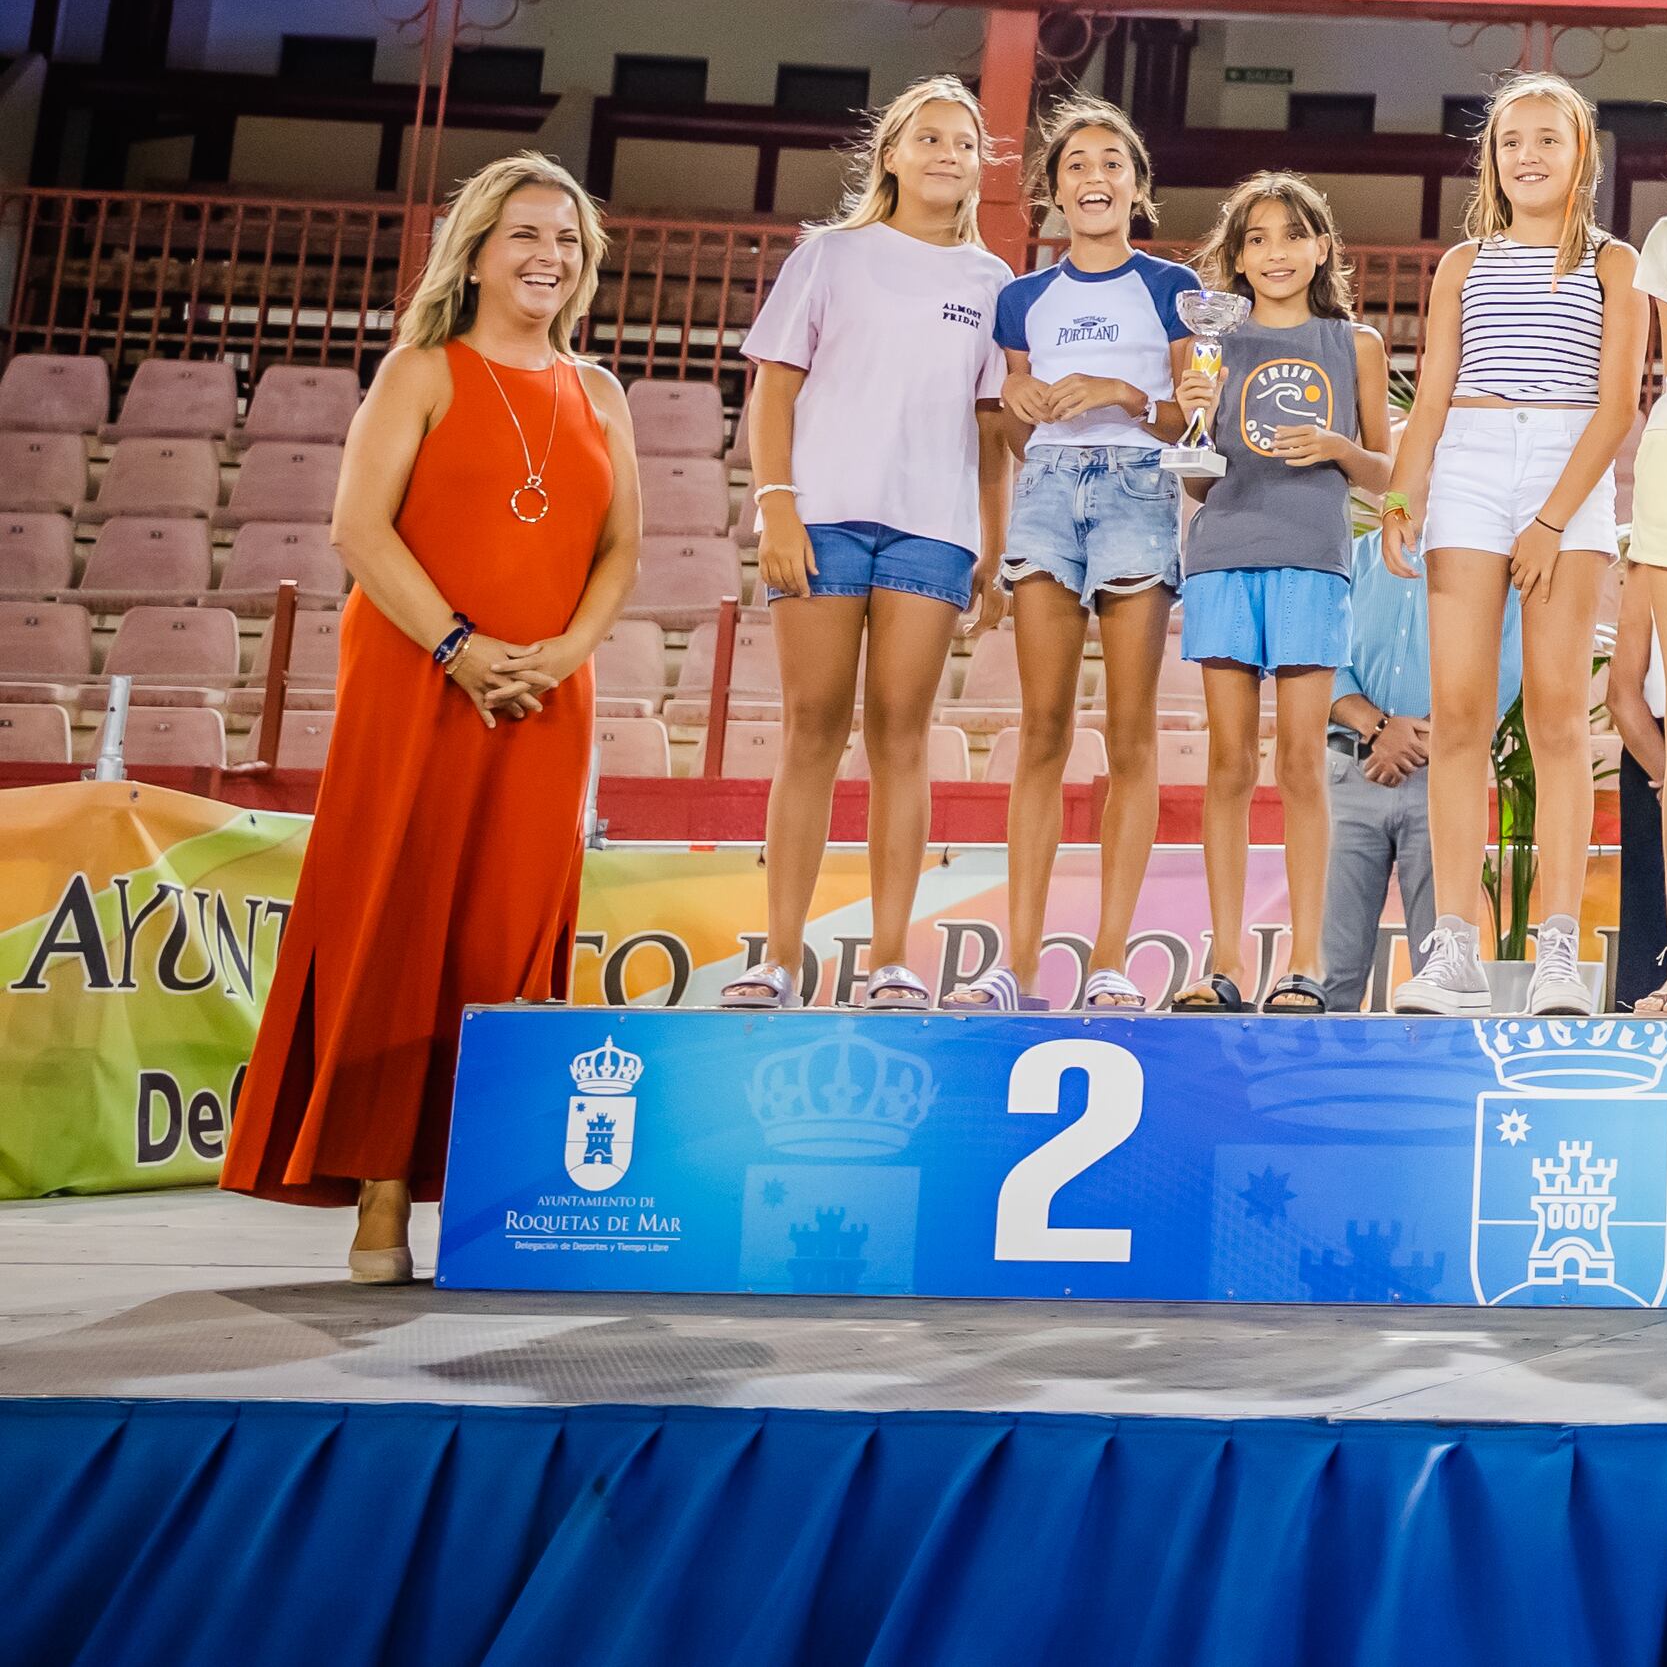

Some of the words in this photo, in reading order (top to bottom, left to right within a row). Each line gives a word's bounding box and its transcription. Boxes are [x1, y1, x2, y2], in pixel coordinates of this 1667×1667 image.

[942, 302, 982, 320] ALMOST
[942, 312, 981, 330] FRIDAY
[1055, 323, 1120, 347] PORTLAND
[1257, 363, 1314, 387] FRESH
[992, 1037, 1145, 1263] 2
[537, 1195, 636, 1207] AYUNTAMIENTO
[639, 1196, 656, 1208] DE
[505, 1209, 600, 1234] ROQUETAS
[607, 1215, 630, 1232] DE
[637, 1213, 682, 1232] MAR
[560, 1241, 571, 1251] de
[572, 1241, 609, 1252] Deportes
[609, 1243, 616, 1253] y
[616, 1242, 648, 1253] Tiempo
[648, 1243, 669, 1252] Libre
